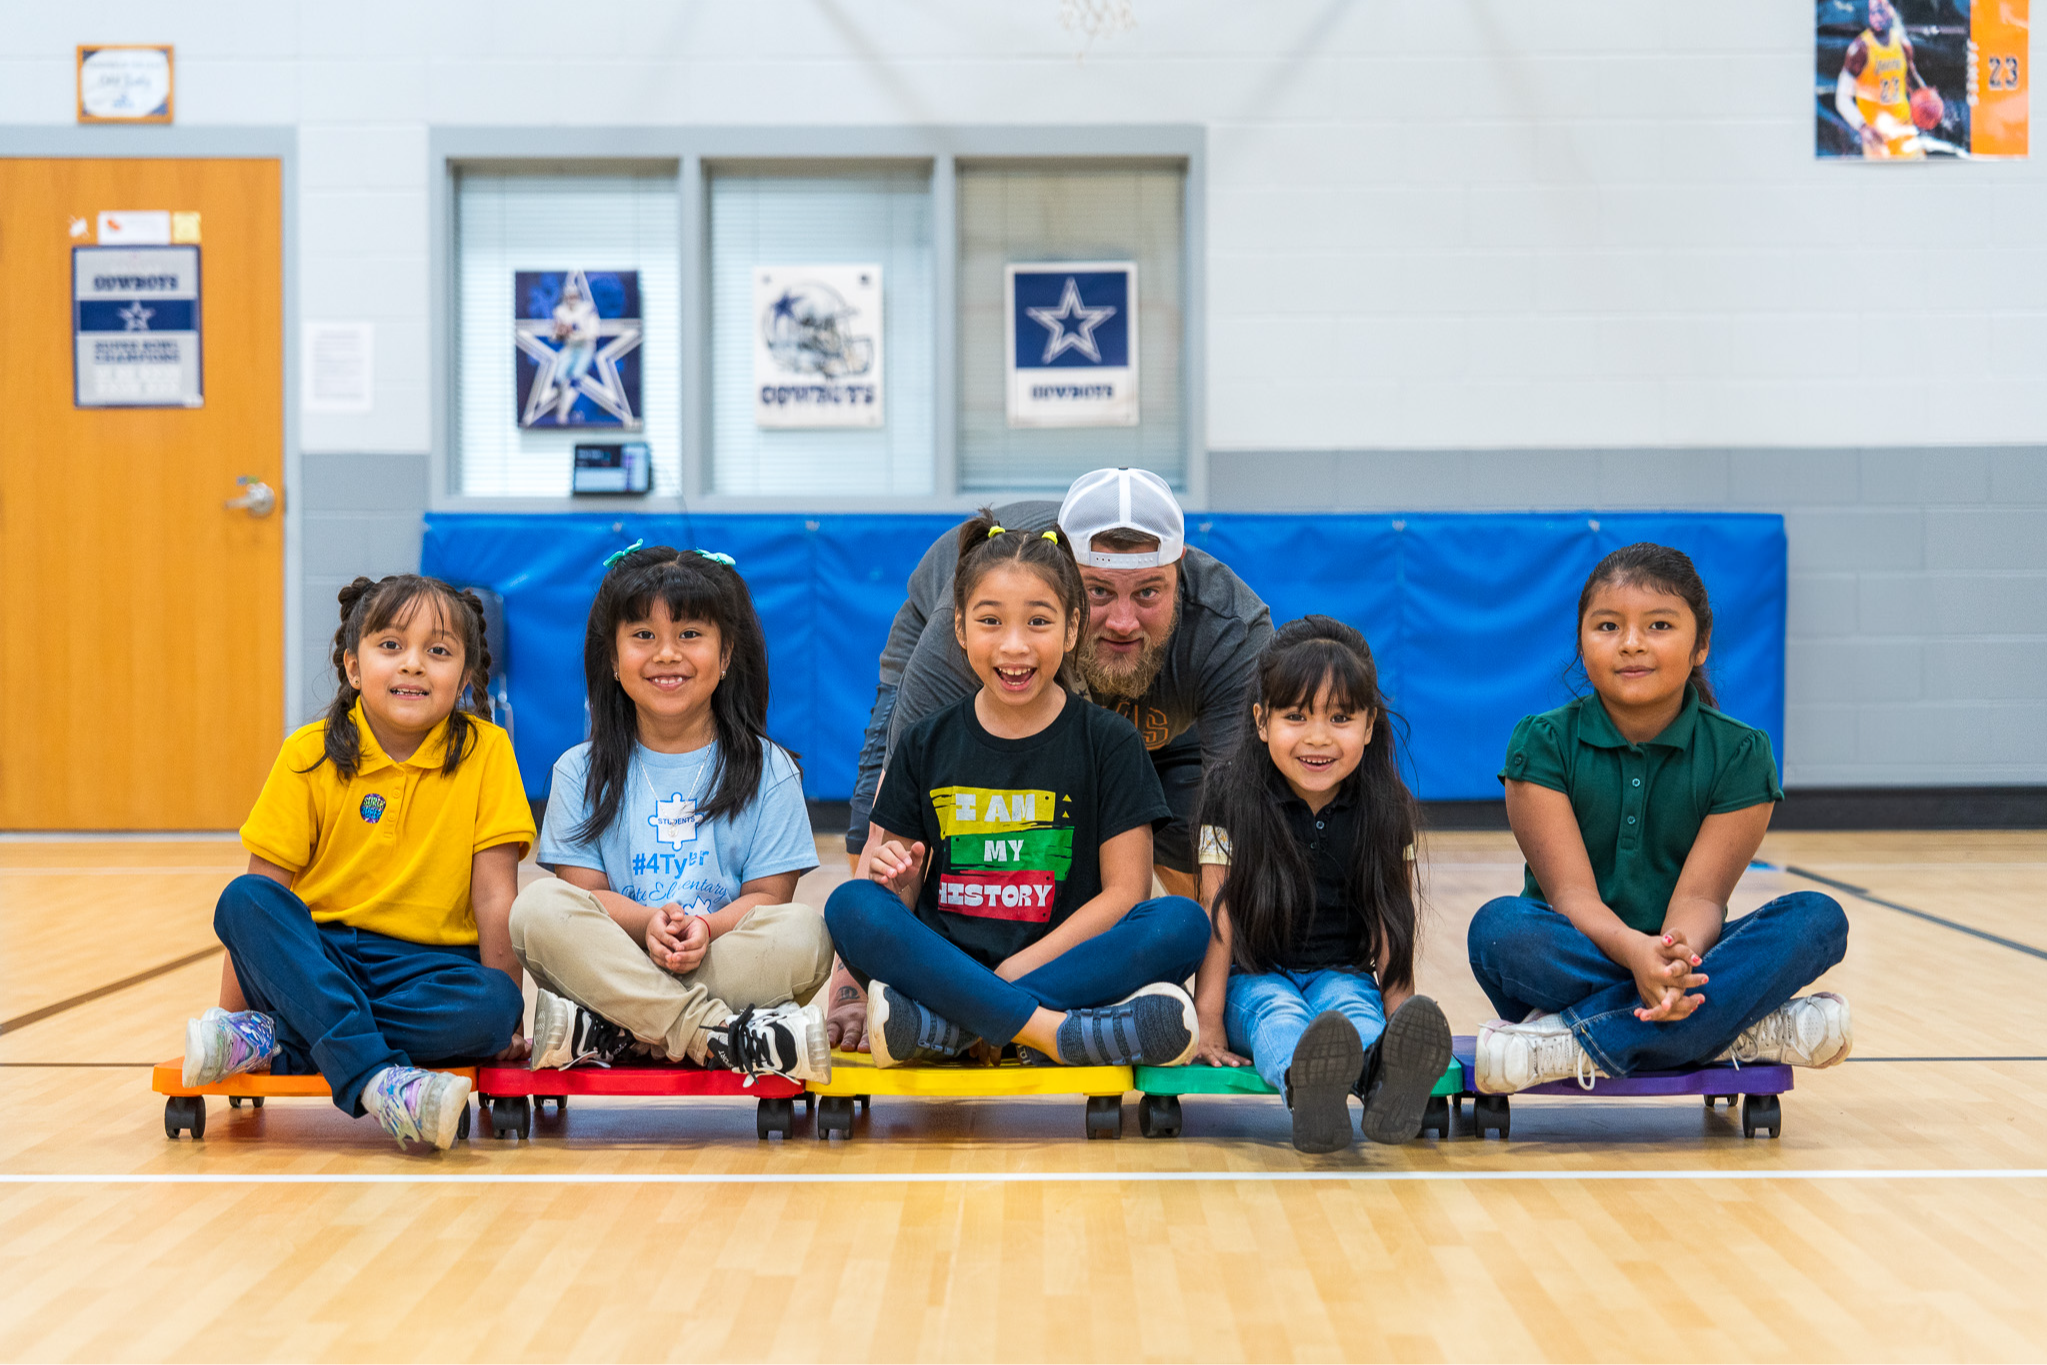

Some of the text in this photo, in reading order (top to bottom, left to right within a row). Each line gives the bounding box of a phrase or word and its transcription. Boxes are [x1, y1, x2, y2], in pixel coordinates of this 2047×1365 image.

[1988, 56, 2018, 90] 23
[956, 794, 1035, 822] I AM
[984, 840, 1024, 862] MY
[939, 882, 1053, 907] HISTORY
